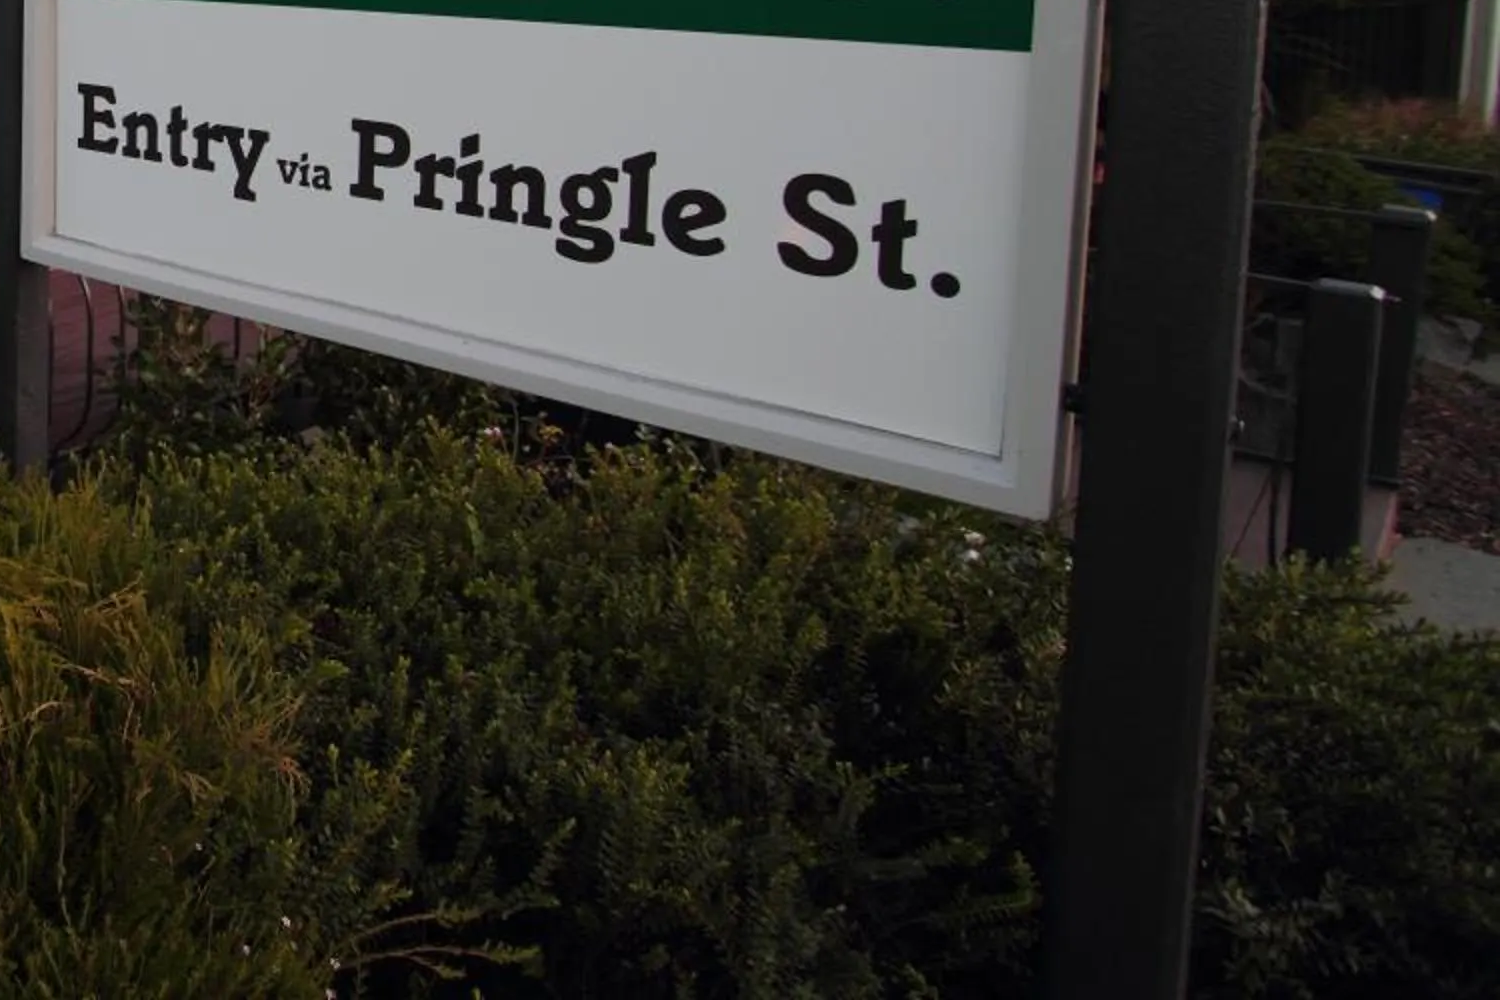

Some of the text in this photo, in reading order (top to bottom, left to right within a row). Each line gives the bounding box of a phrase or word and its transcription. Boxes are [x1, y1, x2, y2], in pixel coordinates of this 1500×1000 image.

[77, 83, 961, 299] Entry via Pringle St.
